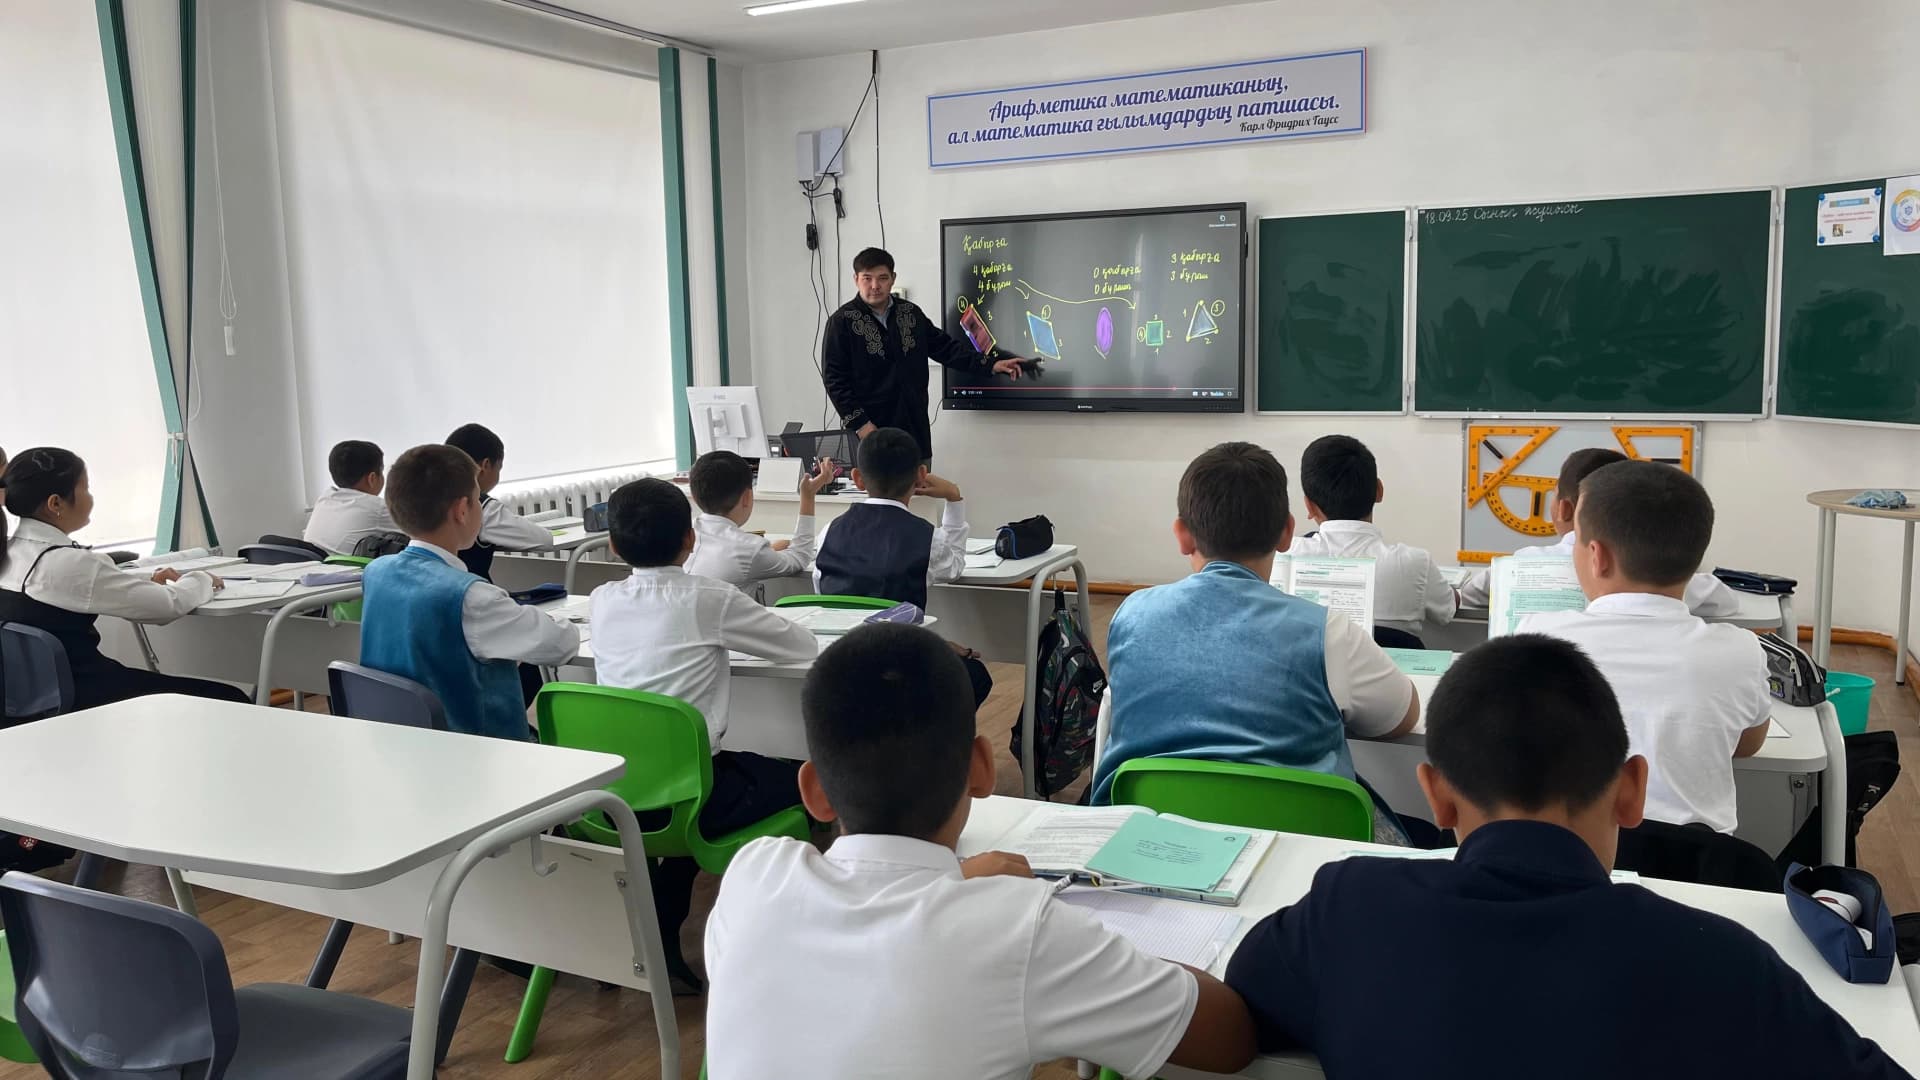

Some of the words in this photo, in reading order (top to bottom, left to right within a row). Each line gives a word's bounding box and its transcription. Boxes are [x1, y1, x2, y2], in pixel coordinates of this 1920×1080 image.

[989, 93, 1107, 123] Арифметика
[1110, 76, 1288, 106] математиканың,
[948, 130, 969, 145] ал
[972, 118, 1093, 143] математика
[1237, 95, 1340, 118] патшасы.
[1239, 121, 1265, 134] Карл
[1266, 117, 1311, 132] Фридрих
[1312, 114, 1339, 127] Гаусс
[1424, 208, 1469, 224] 18.09.25
